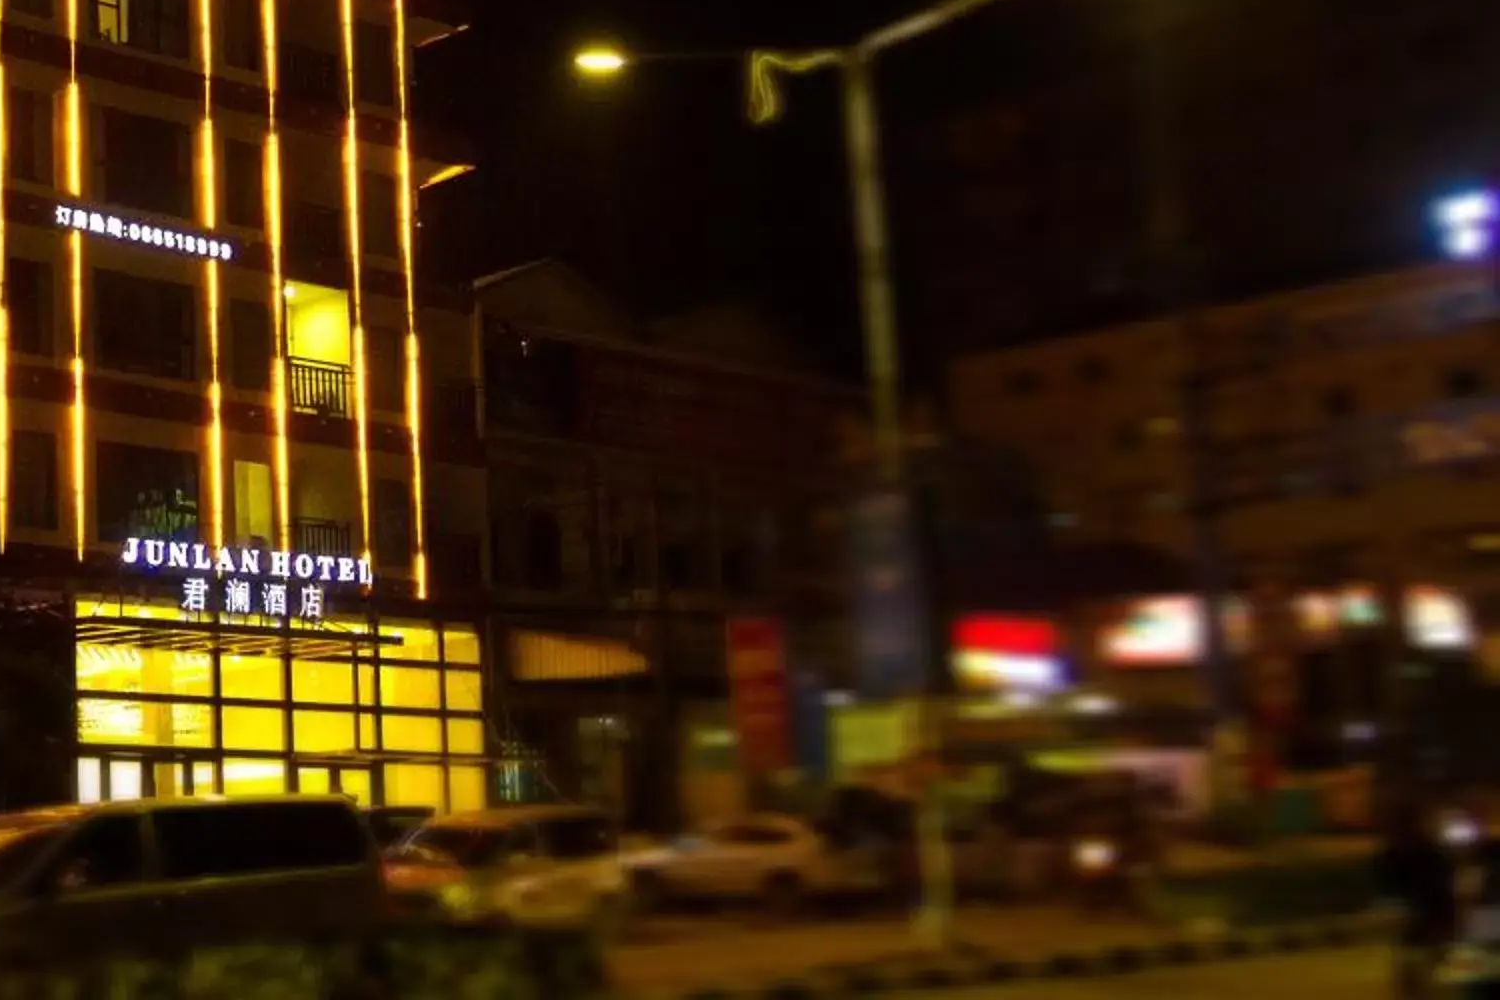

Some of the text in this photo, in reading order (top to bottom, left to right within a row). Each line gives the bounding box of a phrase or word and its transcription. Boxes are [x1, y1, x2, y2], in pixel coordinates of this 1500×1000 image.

[122, 537, 373, 585] JUNLAN HOTEL
[182, 577, 323, 618] 君澜酒店
